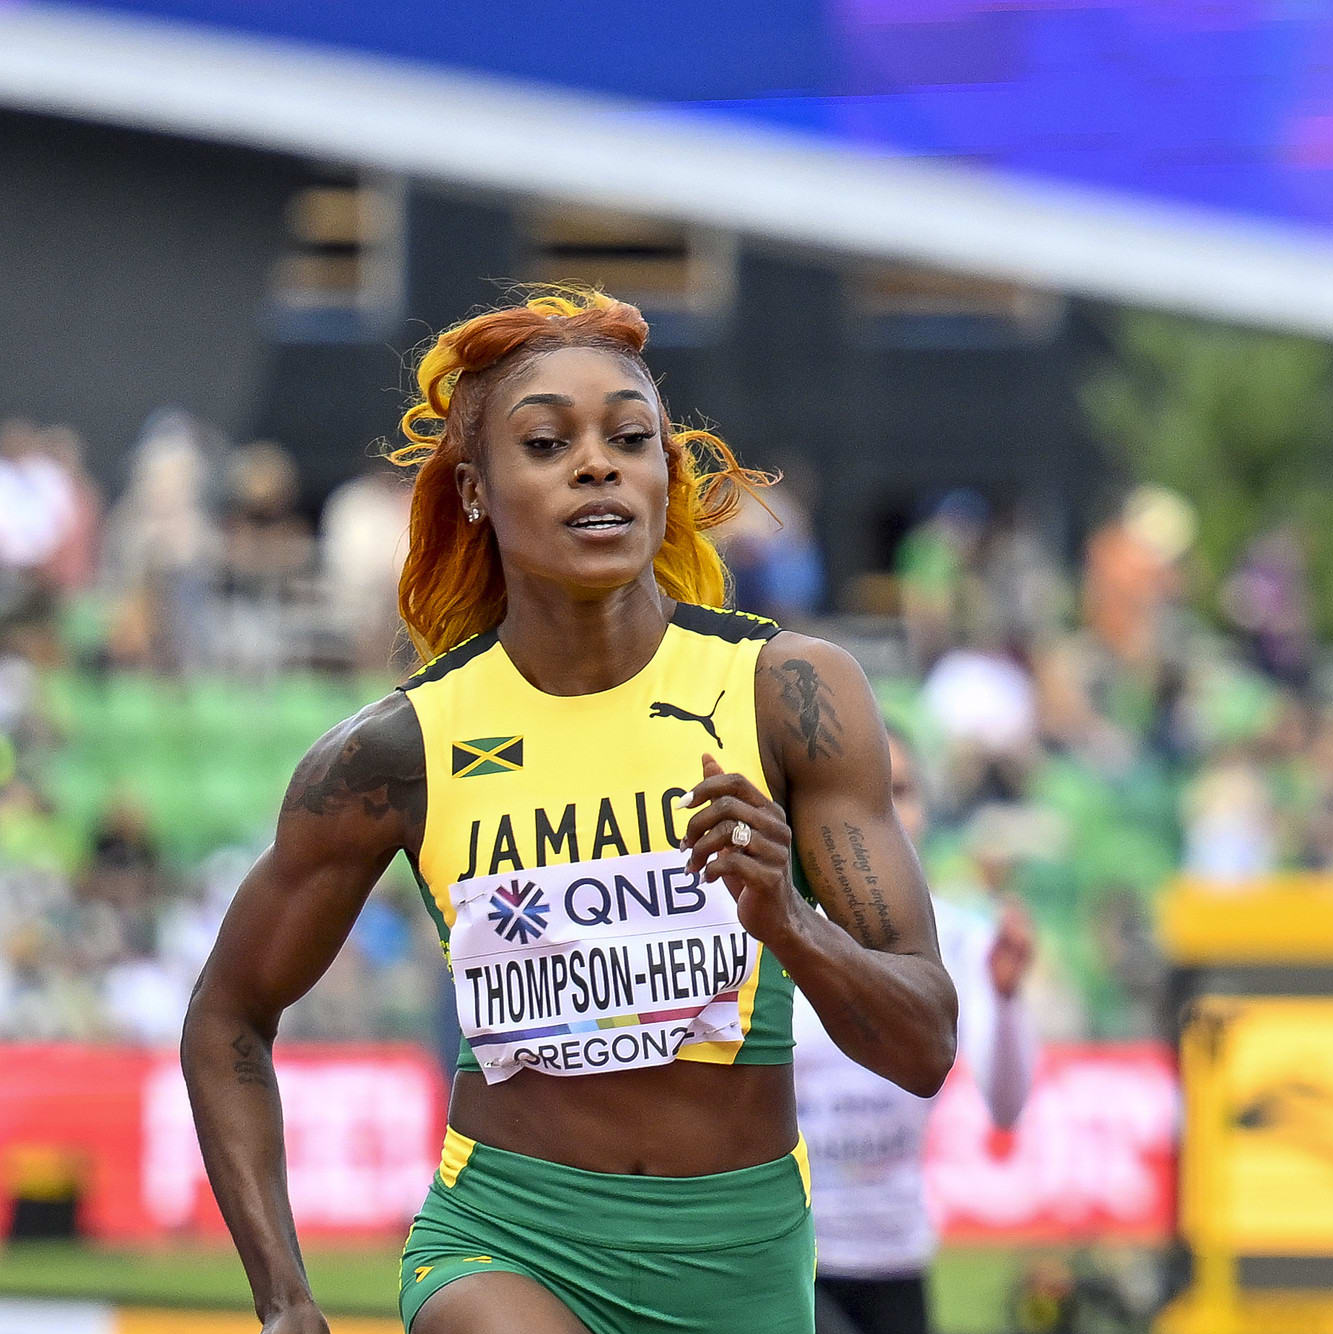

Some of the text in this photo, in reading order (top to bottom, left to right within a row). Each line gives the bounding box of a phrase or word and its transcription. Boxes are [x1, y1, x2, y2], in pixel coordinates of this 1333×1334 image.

[457, 787, 688, 882] JAMAIC
[564, 867, 707, 926] QNB
[465, 931, 748, 1029] THOMPSON-HERAH
